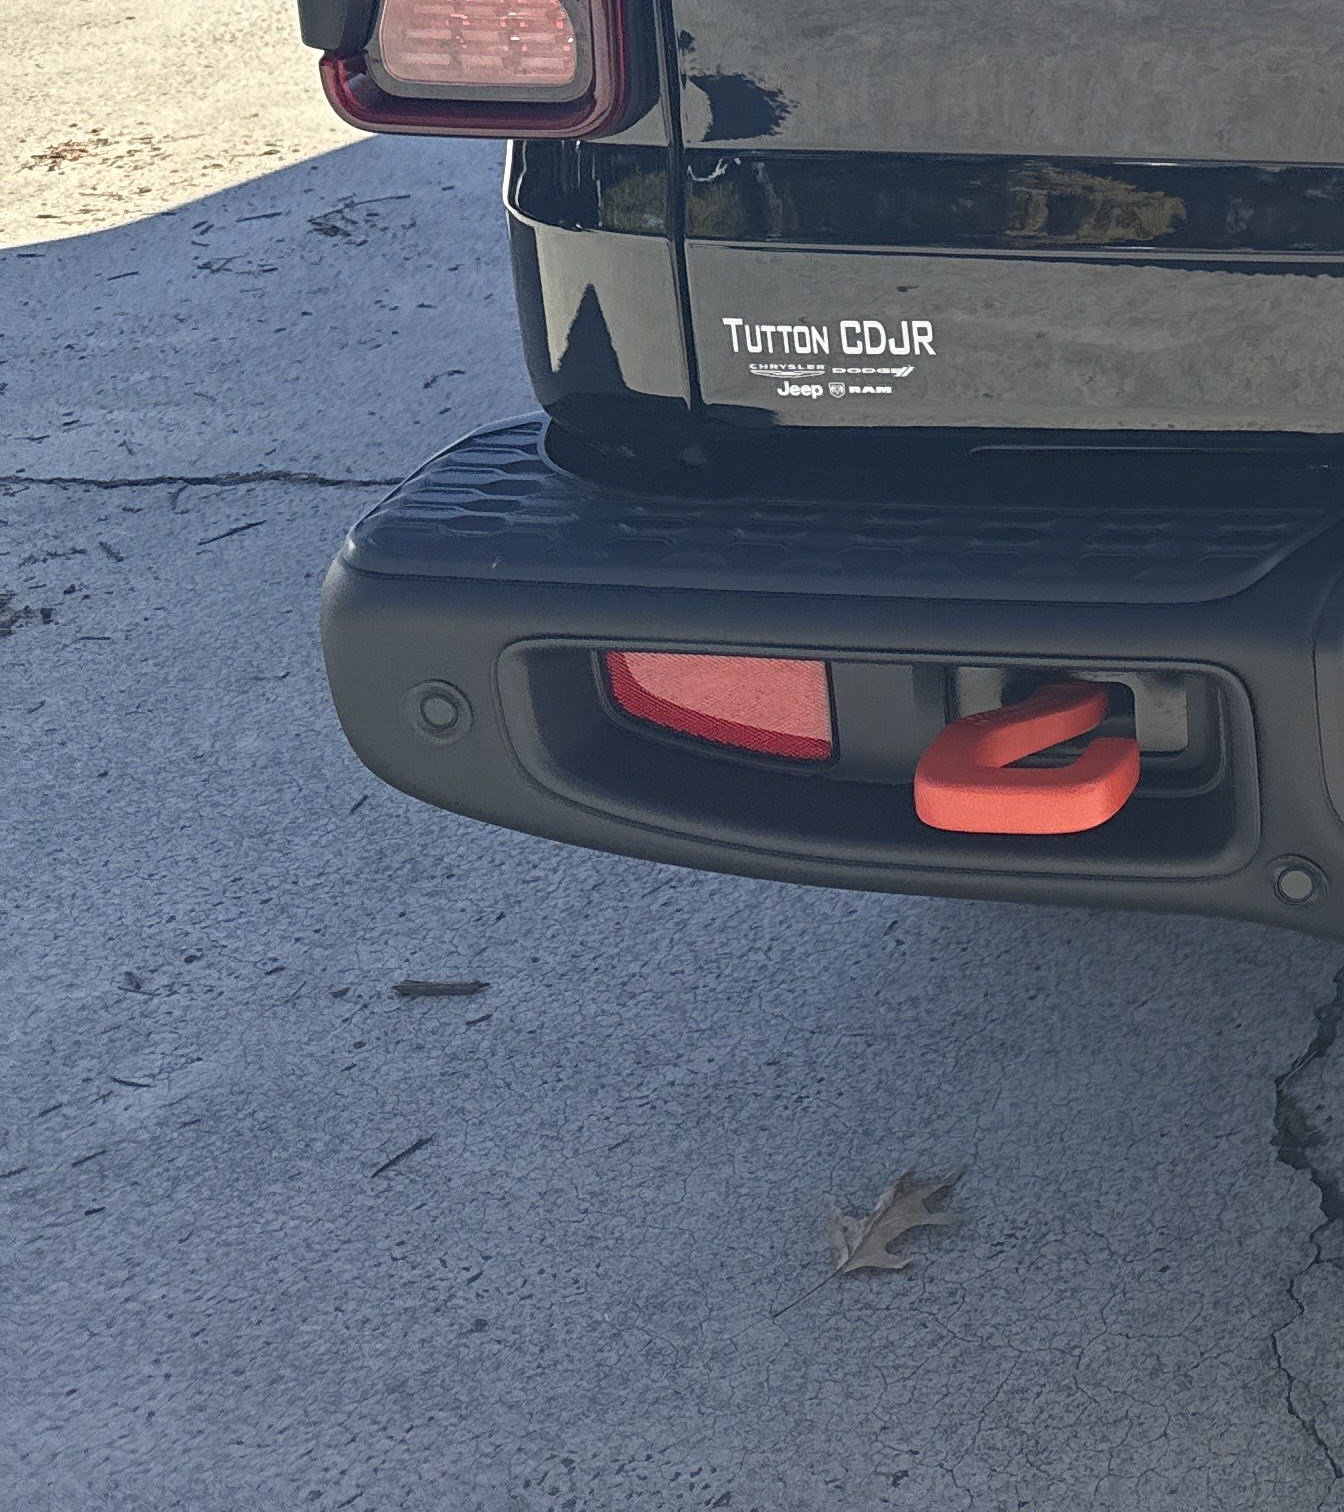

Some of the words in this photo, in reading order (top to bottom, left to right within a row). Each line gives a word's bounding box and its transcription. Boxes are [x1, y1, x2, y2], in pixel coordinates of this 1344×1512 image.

[840, 320, 937, 356] CDJR
[777, 380, 824, 399] Jeep
[848, 386, 892, 394] RAM
